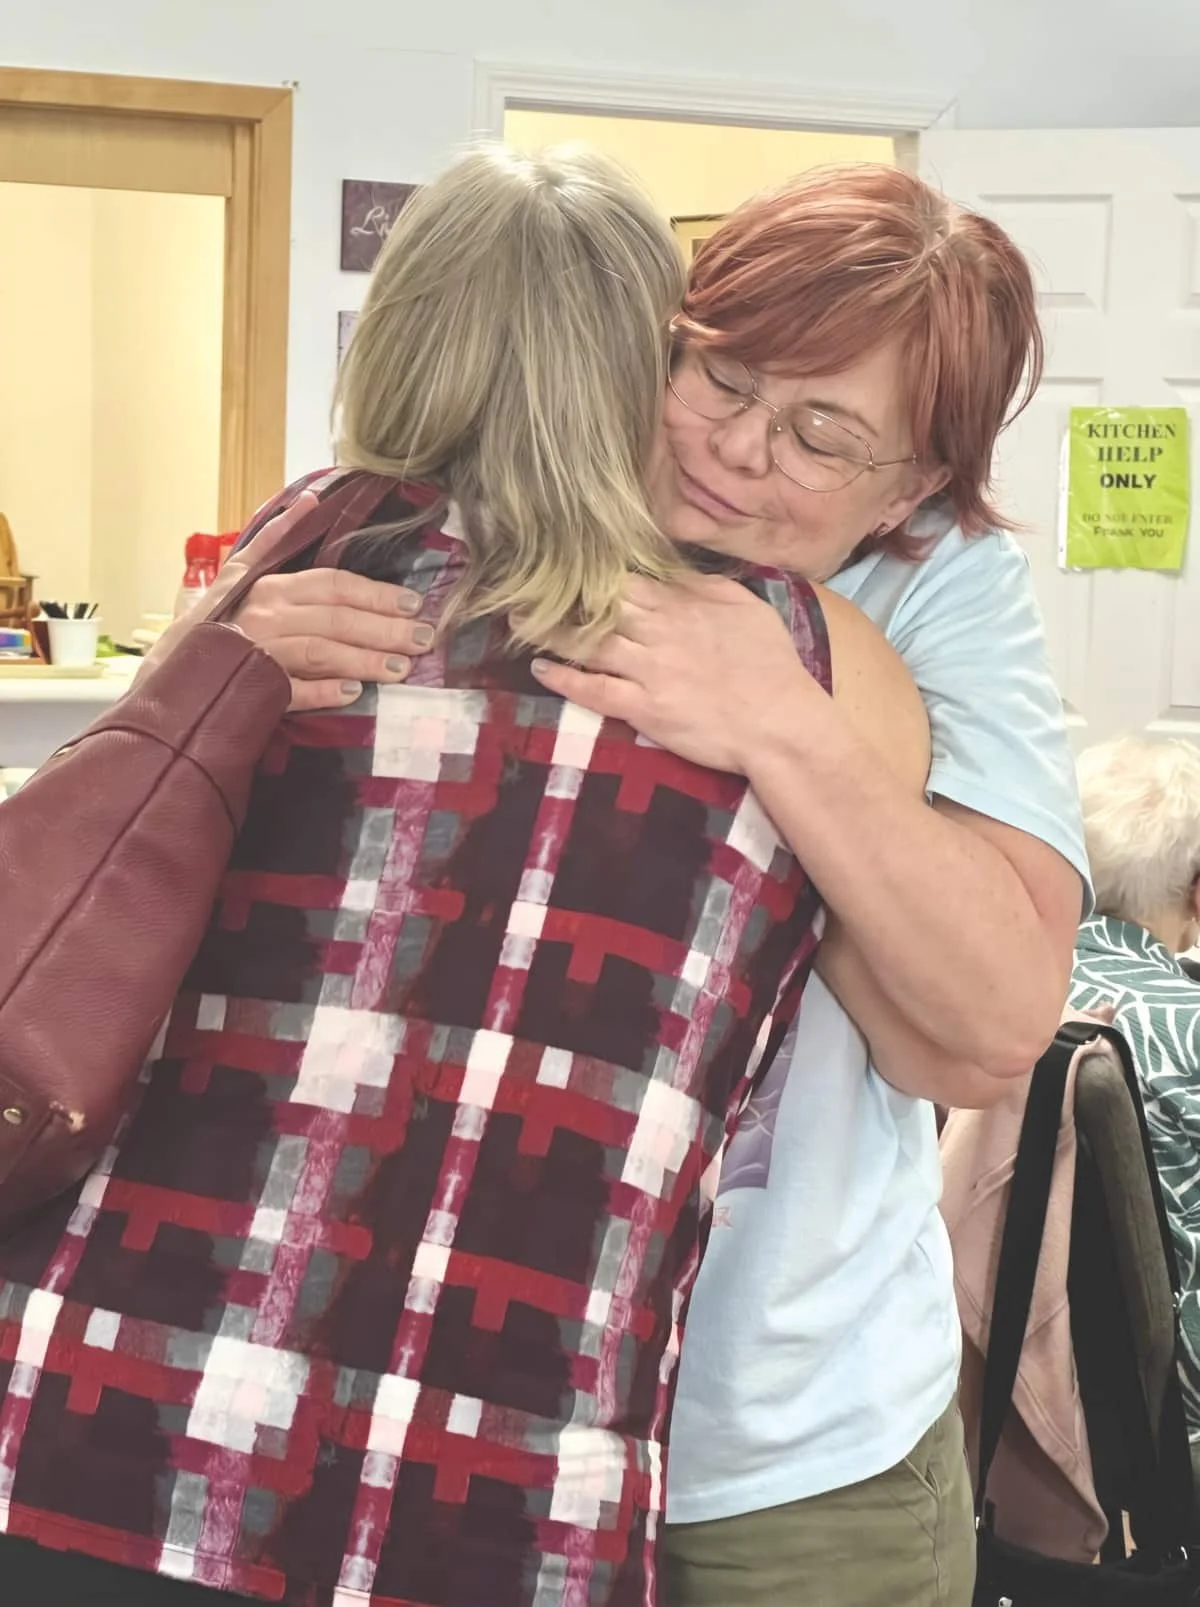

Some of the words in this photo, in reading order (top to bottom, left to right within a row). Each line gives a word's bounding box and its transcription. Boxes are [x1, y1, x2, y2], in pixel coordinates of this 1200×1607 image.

[1087, 423, 1176, 439] KITCHEN
[1098, 446, 1164, 463] HELP
[1100, 473, 1157, 489] ONLY
[1131, 513, 1174, 524] ENTER
